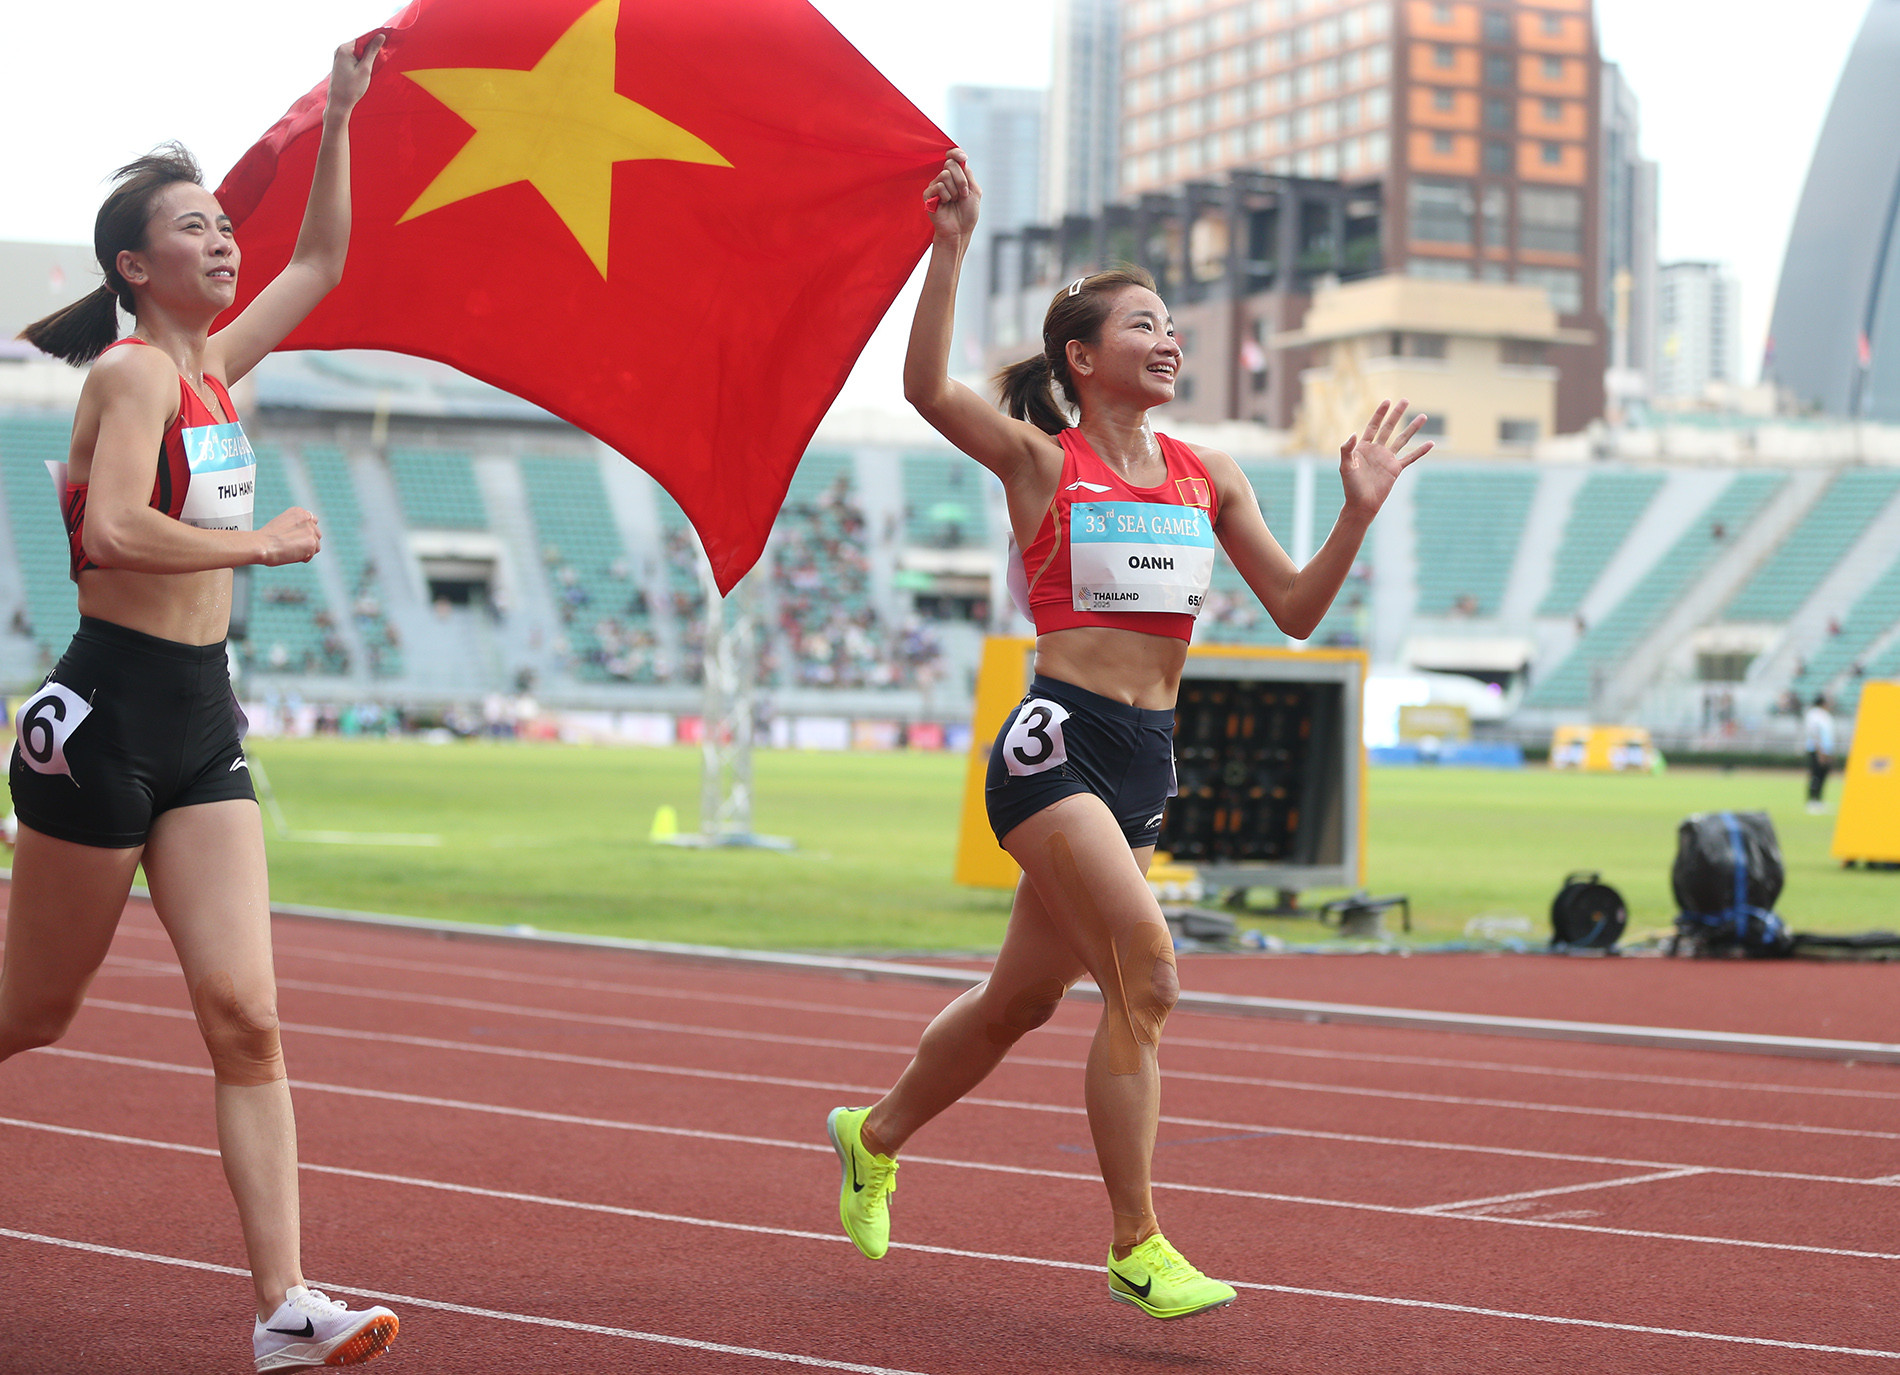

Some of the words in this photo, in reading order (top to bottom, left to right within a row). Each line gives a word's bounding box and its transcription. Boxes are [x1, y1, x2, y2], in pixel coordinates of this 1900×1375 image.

[221, 438, 239, 458] SEA
[218, 484, 238, 499] THU
[1085, 508, 1115, 533] 33rd
[1117, 515, 1147, 533] SEA
[1151, 515, 1200, 537] GAMES
[1128, 556, 1174, 570] OANH
[1093, 592, 1140, 601] THAILAND
[22, 695, 67, 764] 6
[1012, 706, 1054, 766] 3
